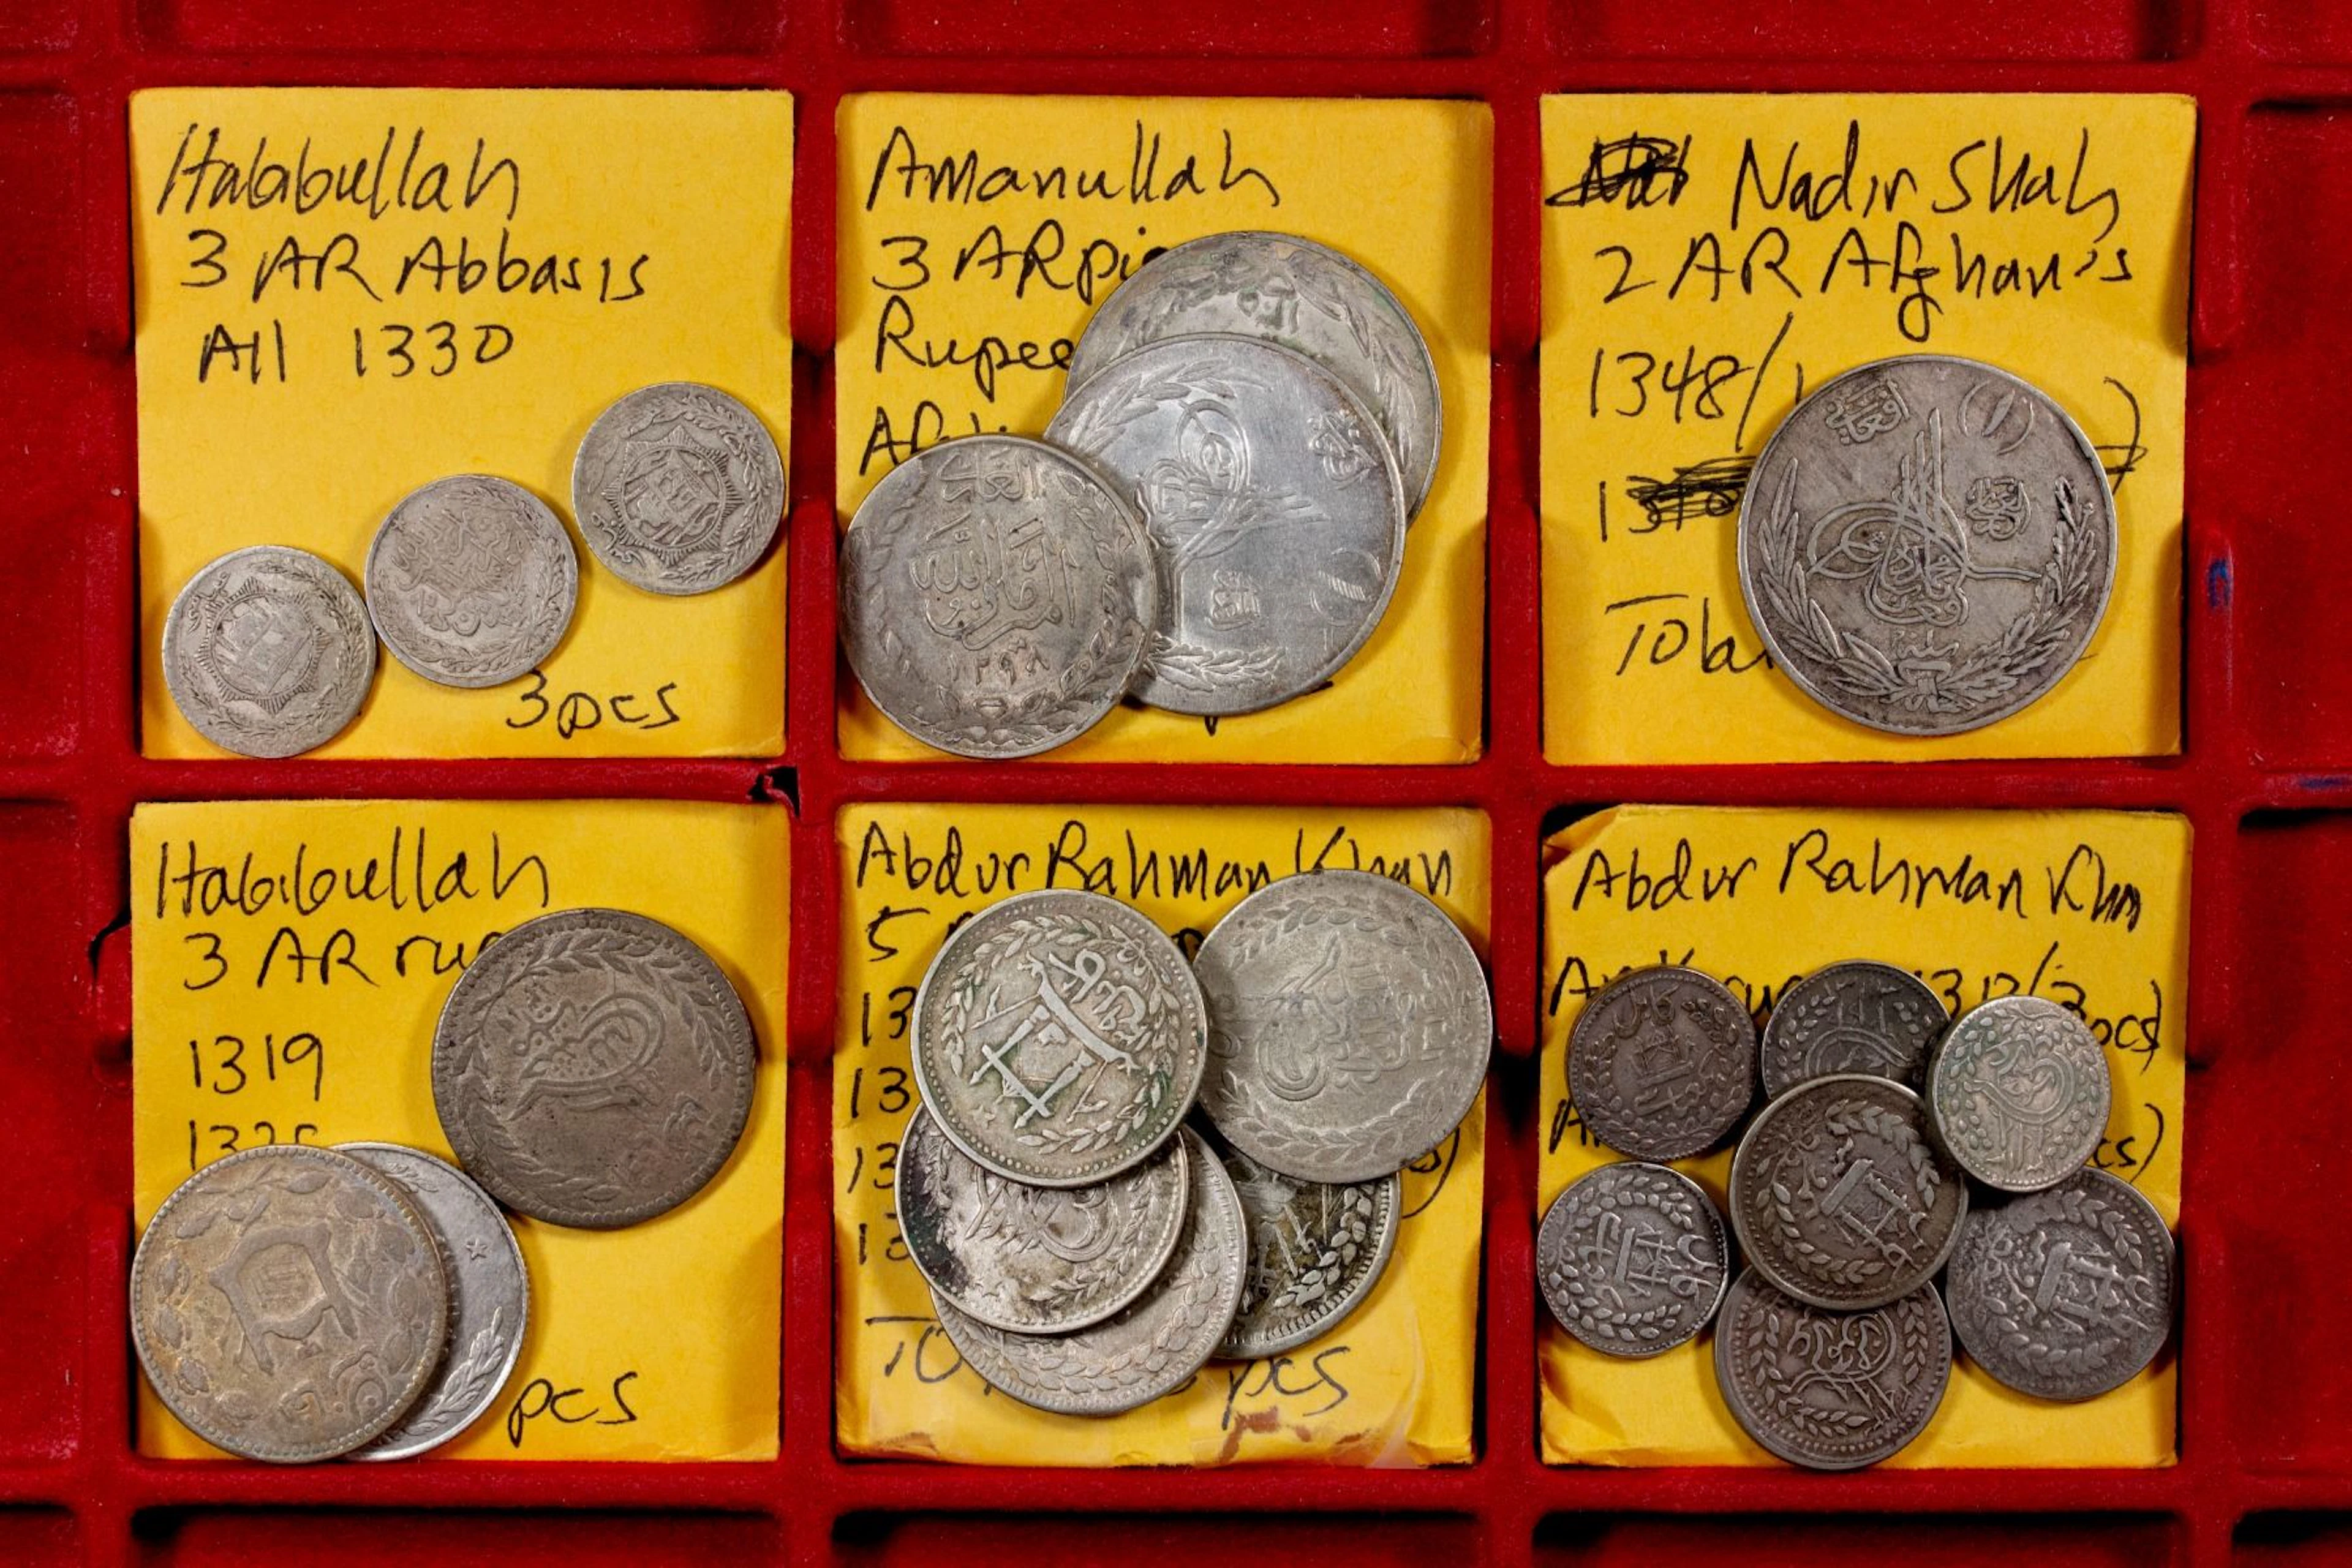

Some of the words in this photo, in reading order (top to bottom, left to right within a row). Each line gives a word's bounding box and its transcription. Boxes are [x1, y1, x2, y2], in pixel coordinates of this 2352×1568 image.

[865, 119, 1280, 211] Amanullah
[1732, 119, 1918, 232] Nadir
[1931, 127, 2120, 245] Shah
[181, 228, 227, 288] 3
[251, 233, 382, 303] AR
[394, 227, 649, 304] Abbasis
[872, 235, 930, 292] 3
[1594, 245, 1656, 304] 2
[1668, 225, 1803, 303] AR
[353, 320, 514, 377] 1330
[156, 826, 549, 921] Habibullah
[856, 821, 1034, 897] Abdur
[1044, 820, 1272, 902] Rahman
[1571, 838, 1757, 912] Abdur
[1779, 827, 2027, 919] Rahman
[183, 932, 228, 991] 3
[256, 927, 379, 987] AR
[867, 905, 931, 962] 5
[189, 1032, 323, 1102] 1319
[508, 1371, 638, 1448] pcs
